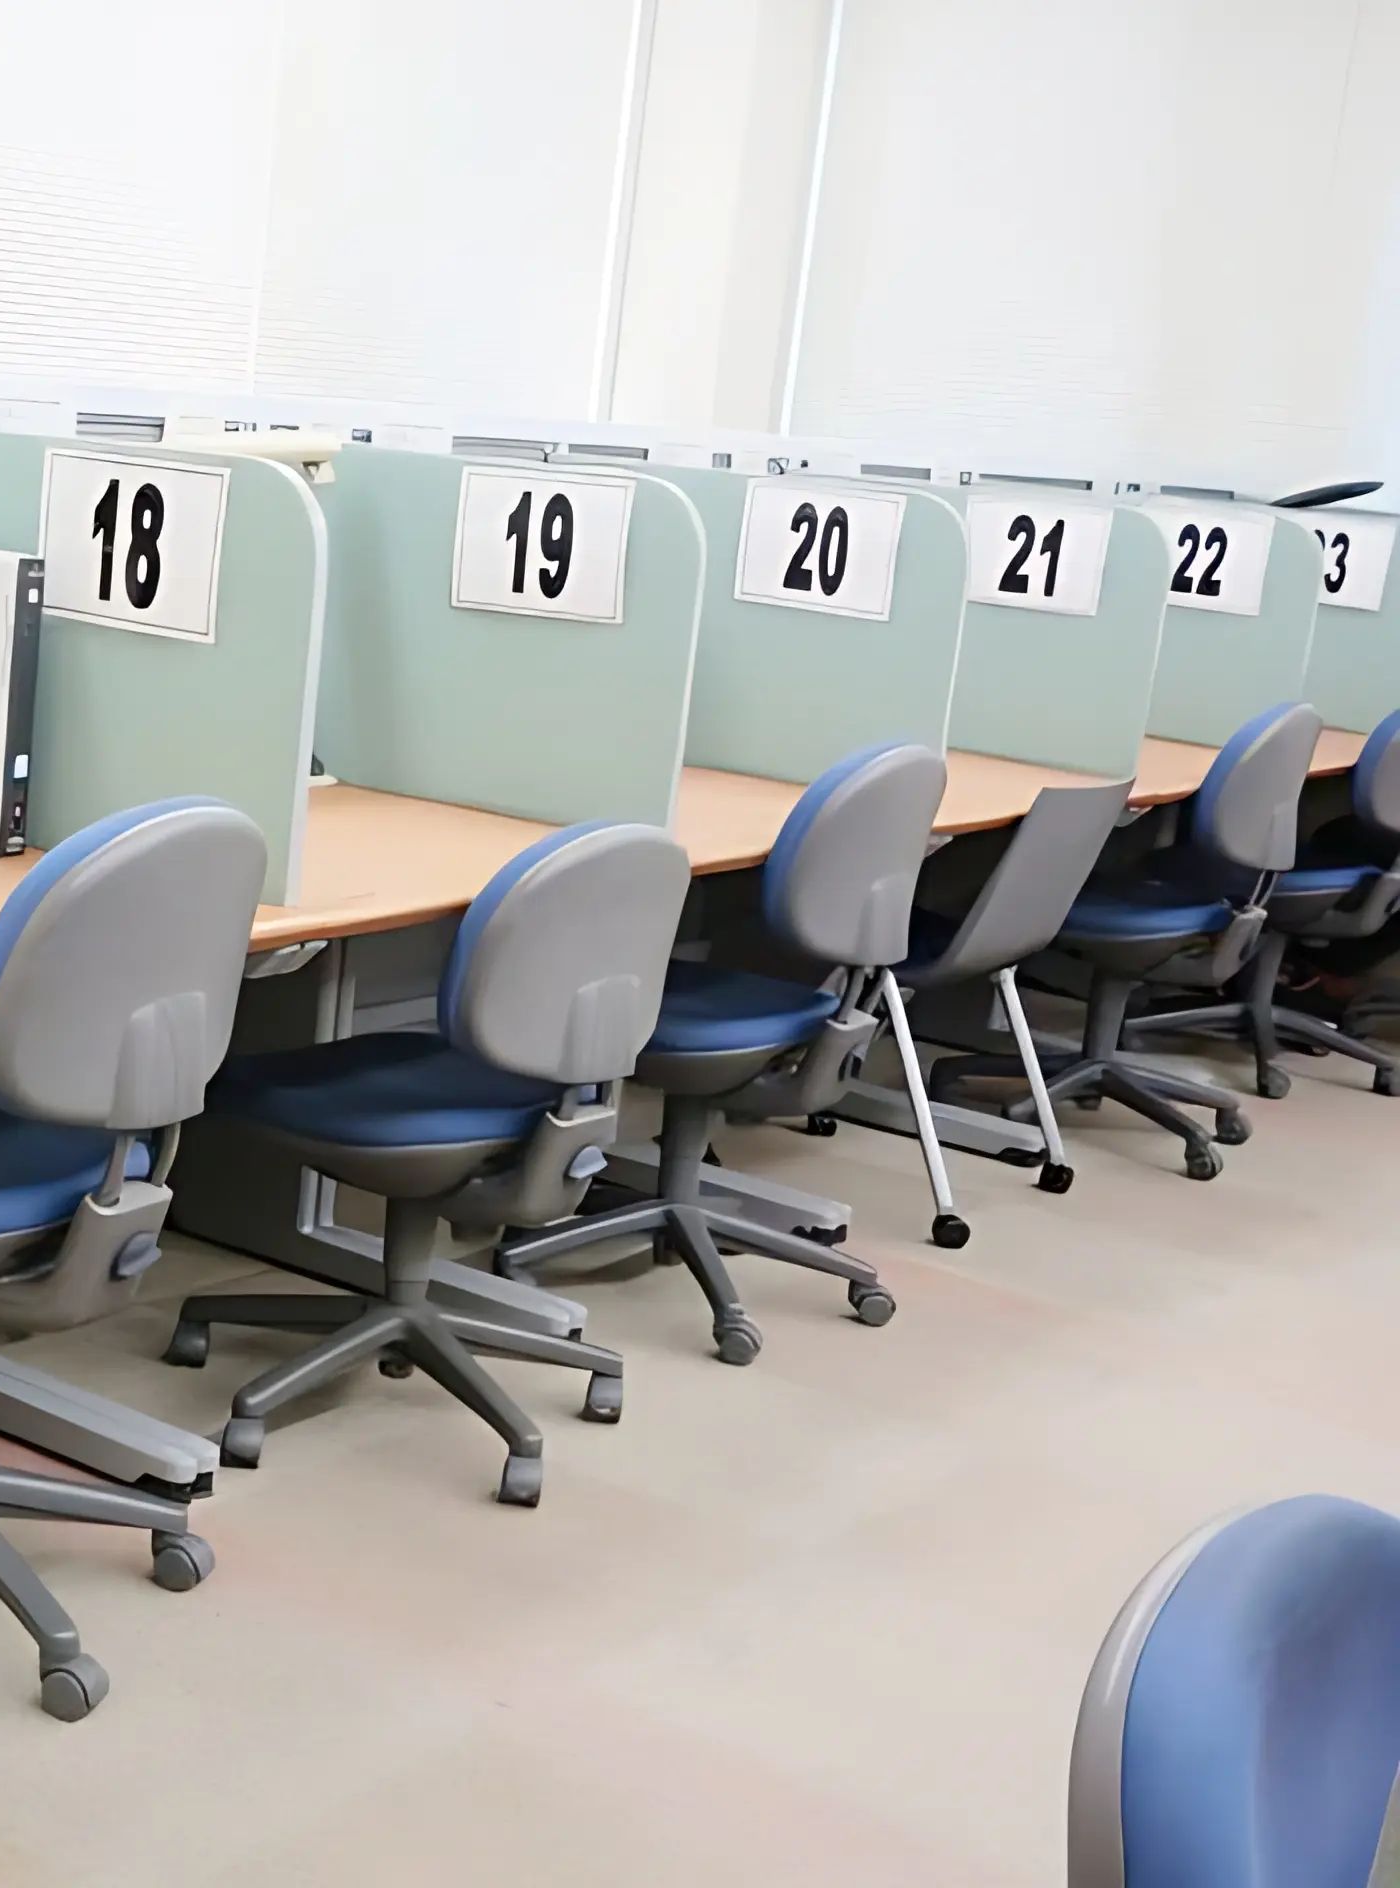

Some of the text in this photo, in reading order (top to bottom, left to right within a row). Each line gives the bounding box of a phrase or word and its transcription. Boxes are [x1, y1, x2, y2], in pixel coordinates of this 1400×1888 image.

[92, 479, 165, 610] 18
[505, 491, 574, 599] 19
[782, 502, 849, 597] 20
[998, 514, 1065, 597] 21
[1170, 523, 1228, 597] 22
[1314, 529, 1350, 594] 3
